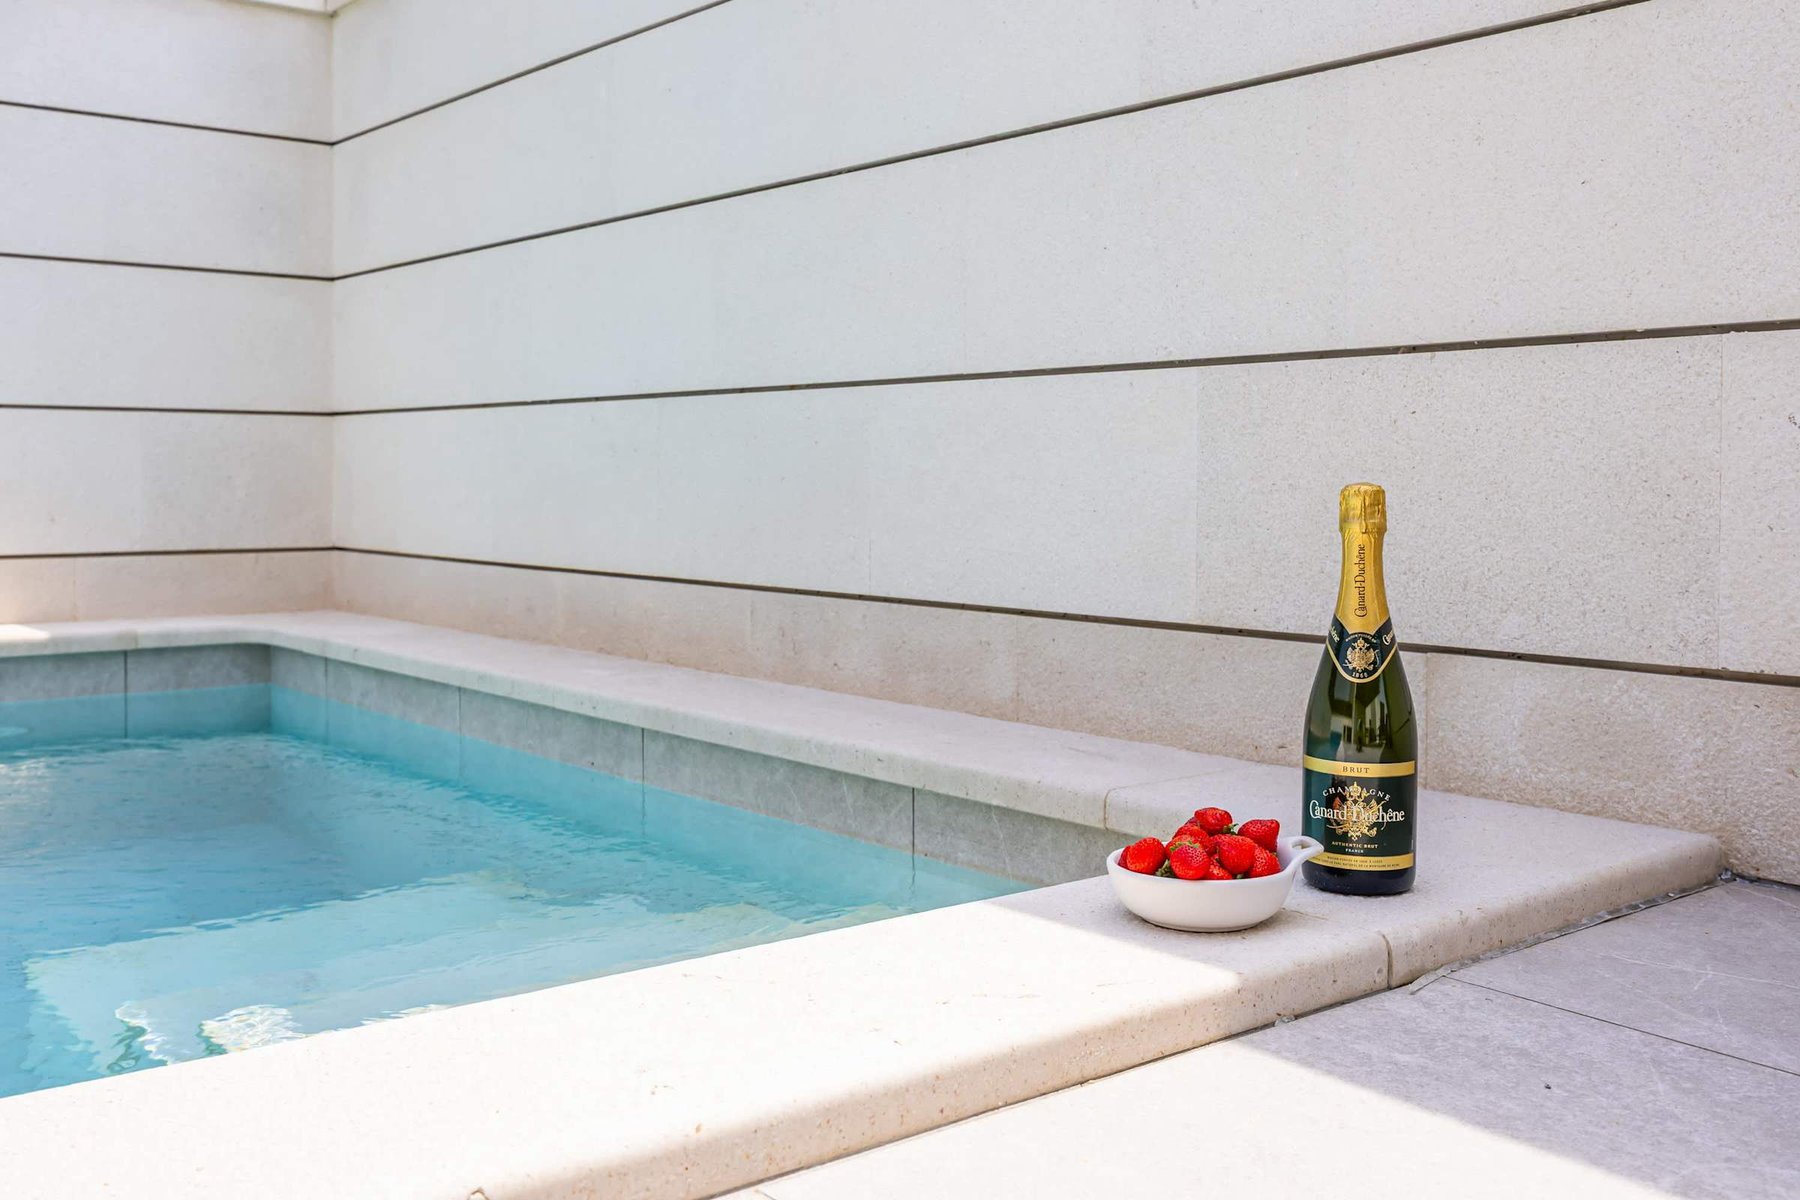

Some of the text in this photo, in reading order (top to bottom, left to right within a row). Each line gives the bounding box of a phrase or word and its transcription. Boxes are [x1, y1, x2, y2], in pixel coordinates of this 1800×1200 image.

[1342, 765, 1370, 774] BRUT
[1322, 785, 1391, 801] CHAMAGNE
[1331, 841, 1362, 849] AUTHENTIC
